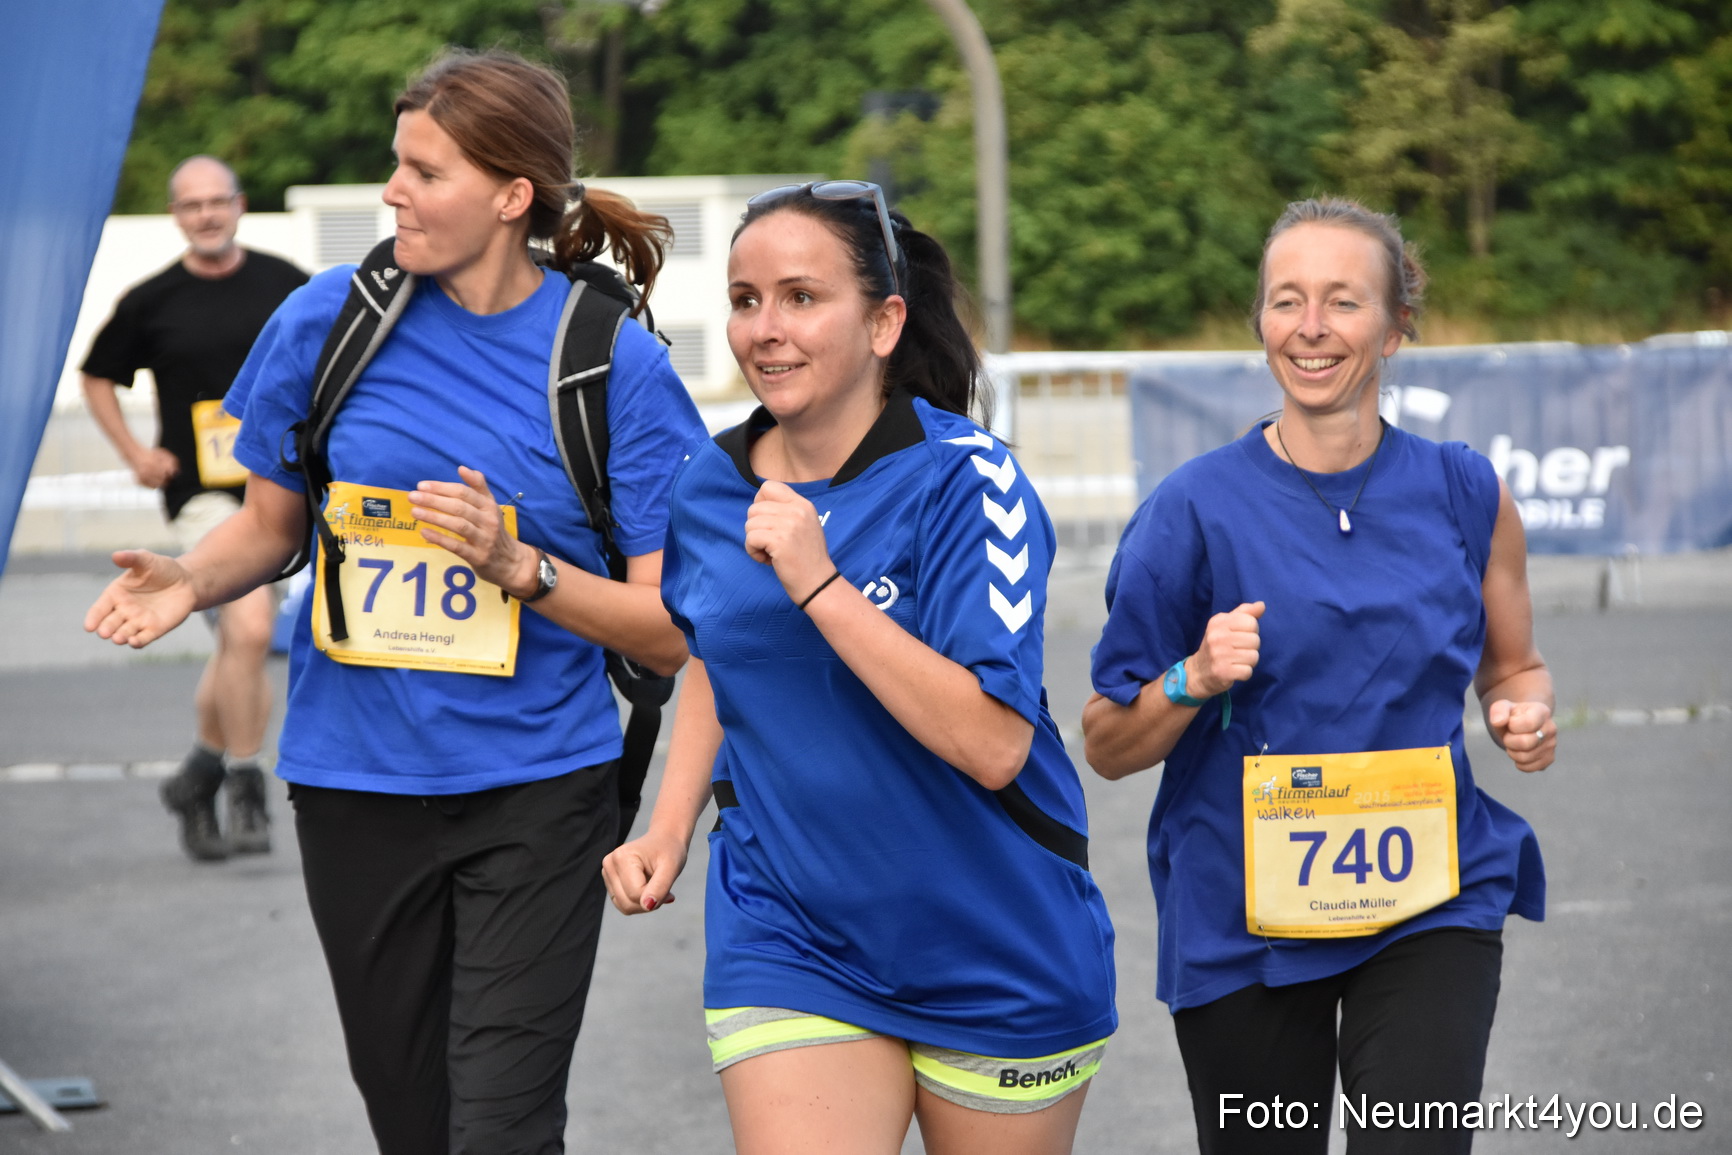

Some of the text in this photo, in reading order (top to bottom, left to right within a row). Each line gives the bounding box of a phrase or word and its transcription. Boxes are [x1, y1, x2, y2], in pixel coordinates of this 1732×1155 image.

[349, 513, 418, 531] firmenlauf
[340, 531, 385, 548] alken
[358, 557, 477, 621] 718
[373, 628, 455, 646] Andrea Hengl
[388, 644, 425, 654] Lebenshilfe
[1278, 784, 1351, 799] firmenlauf
[1257, 806, 1316, 821] walken
[1289, 826, 1414, 887] 740
[1309, 898, 1397, 911] Claudia Müller
[1328, 913, 1365, 922] Lebenshilfe
[998, 1060, 1080, 1088] Bench.
